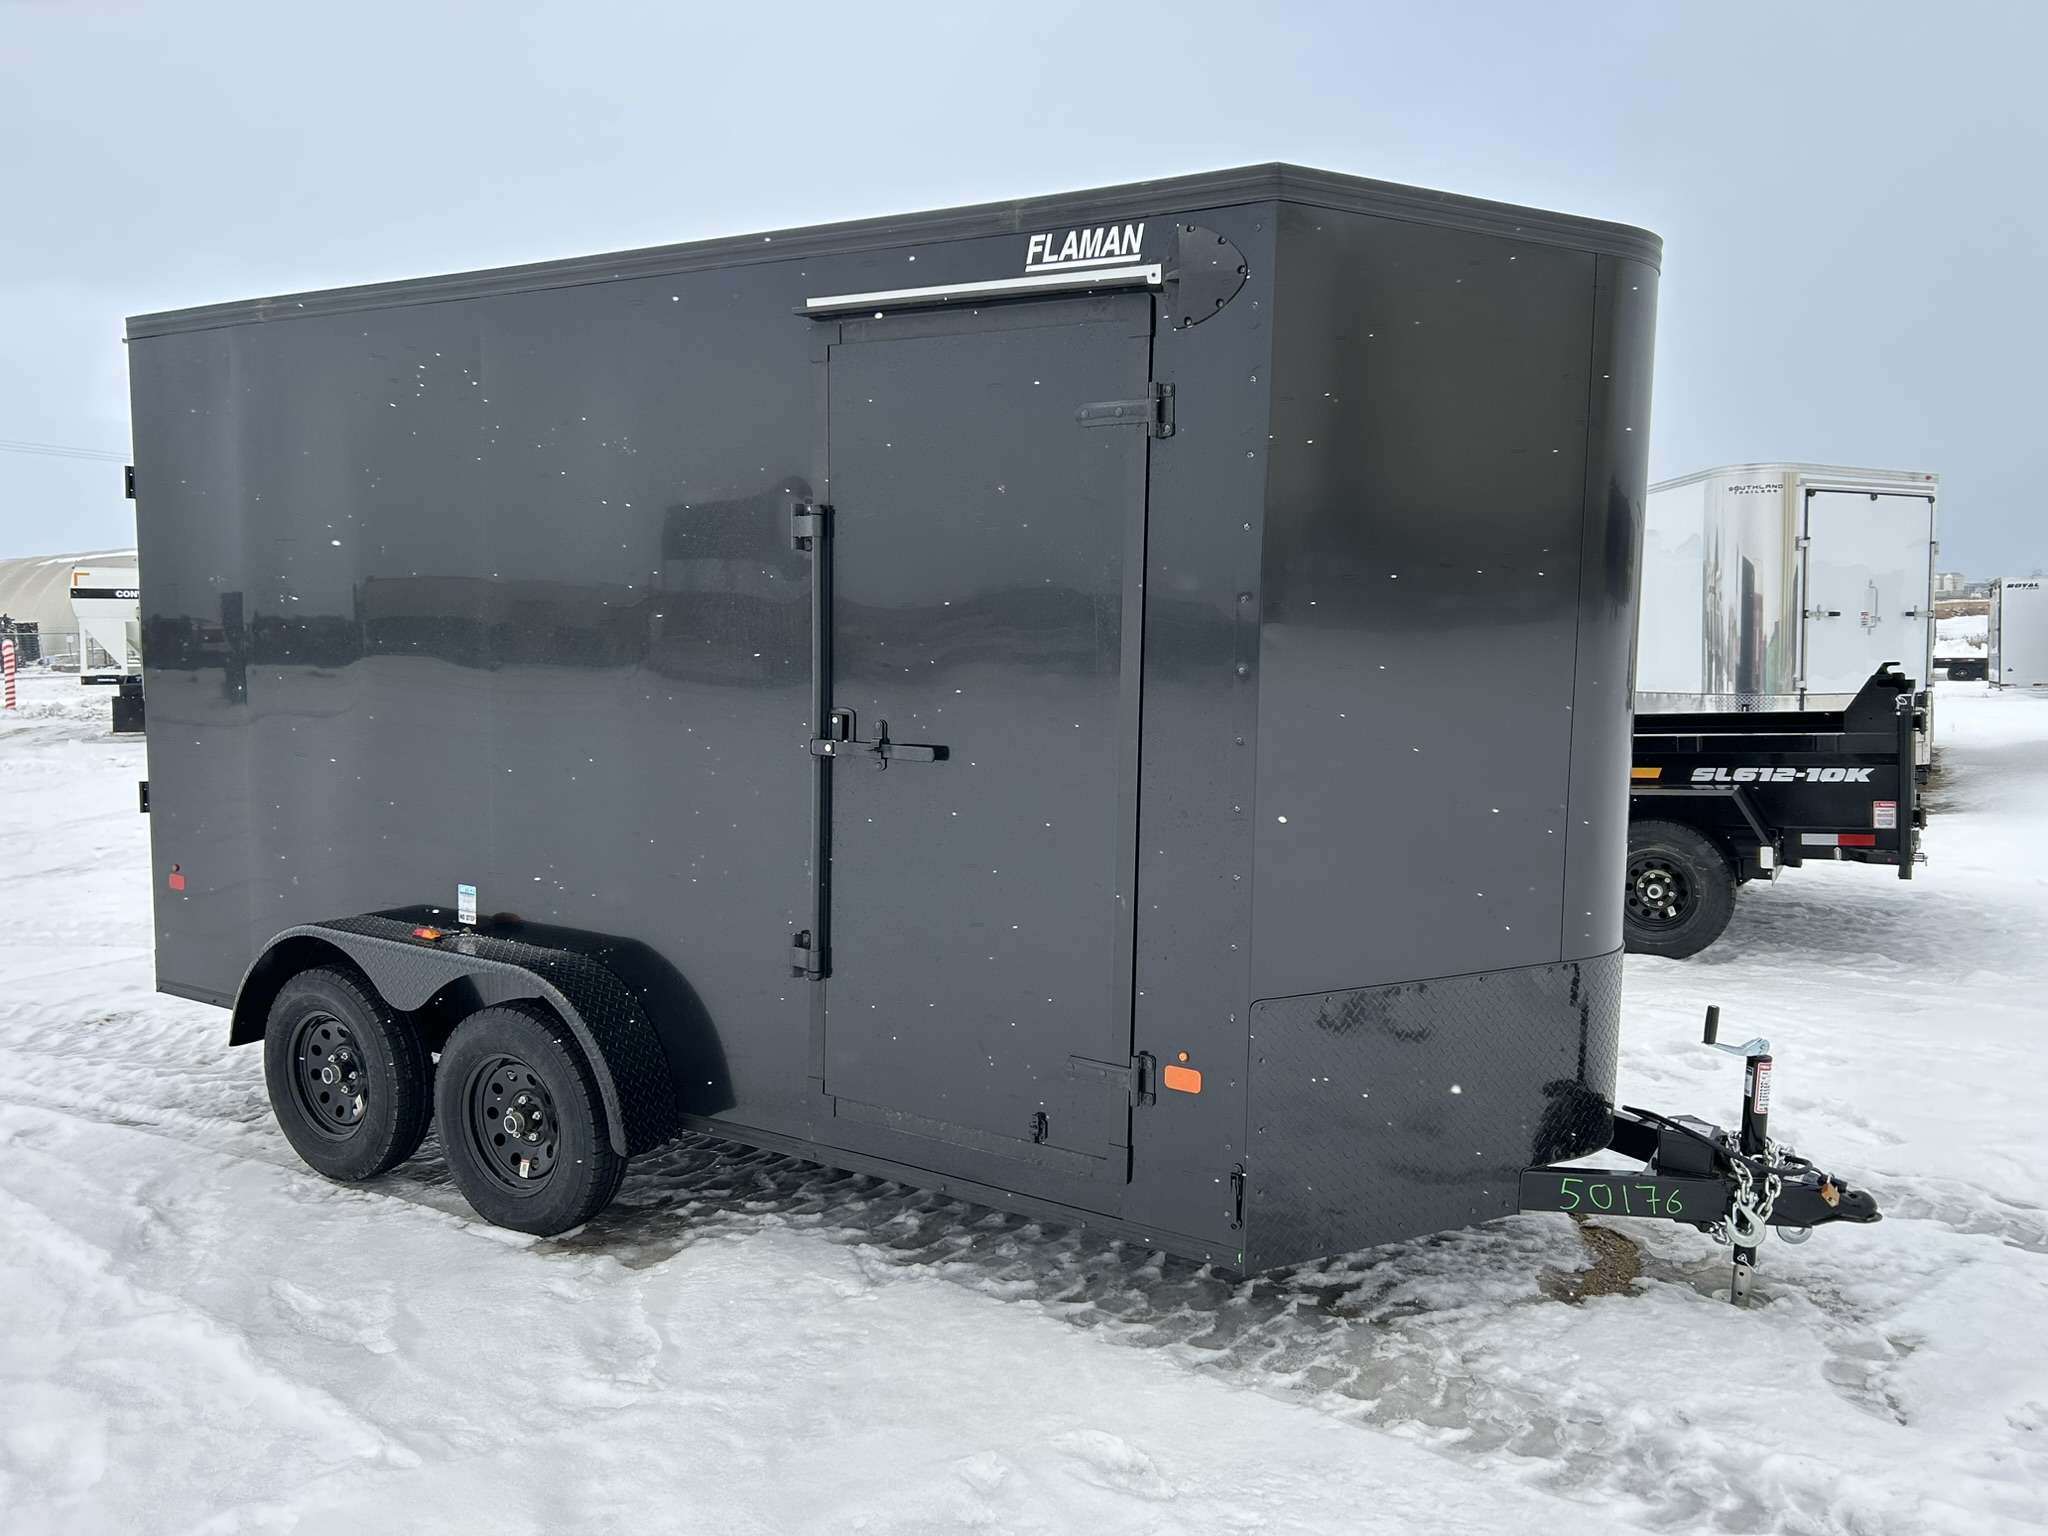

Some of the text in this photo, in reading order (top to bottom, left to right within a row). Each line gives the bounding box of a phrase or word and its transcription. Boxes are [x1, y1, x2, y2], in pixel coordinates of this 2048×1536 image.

[1026, 223, 1144, 264] FLAMAN
[1690, 767, 1875, 783] SL612-10K
[1559, 1177, 1684, 1215] 50176
